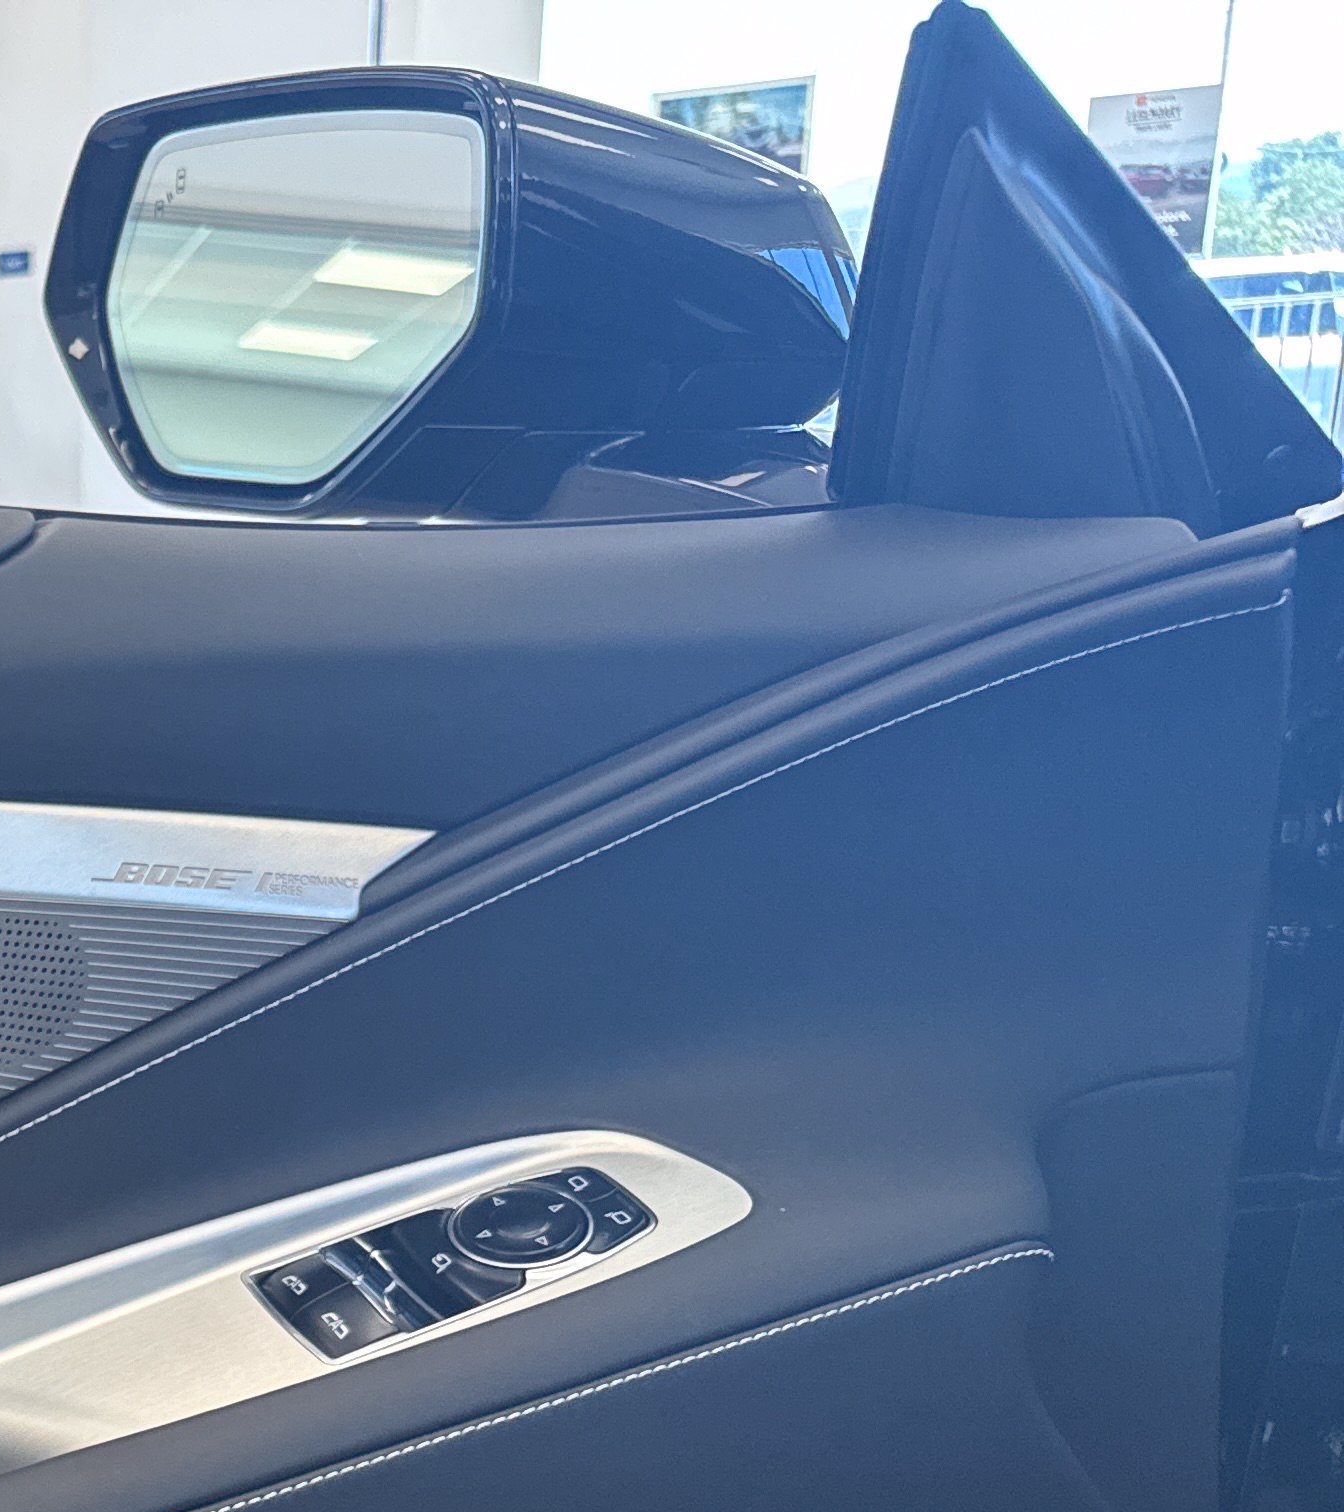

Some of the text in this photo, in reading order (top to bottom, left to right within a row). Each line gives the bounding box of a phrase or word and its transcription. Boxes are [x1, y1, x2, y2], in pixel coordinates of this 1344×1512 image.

[91, 862, 253, 890] BOSE
[273, 872, 360, 889] PERFORMANCE
[267, 883, 304, 897] SERIES
